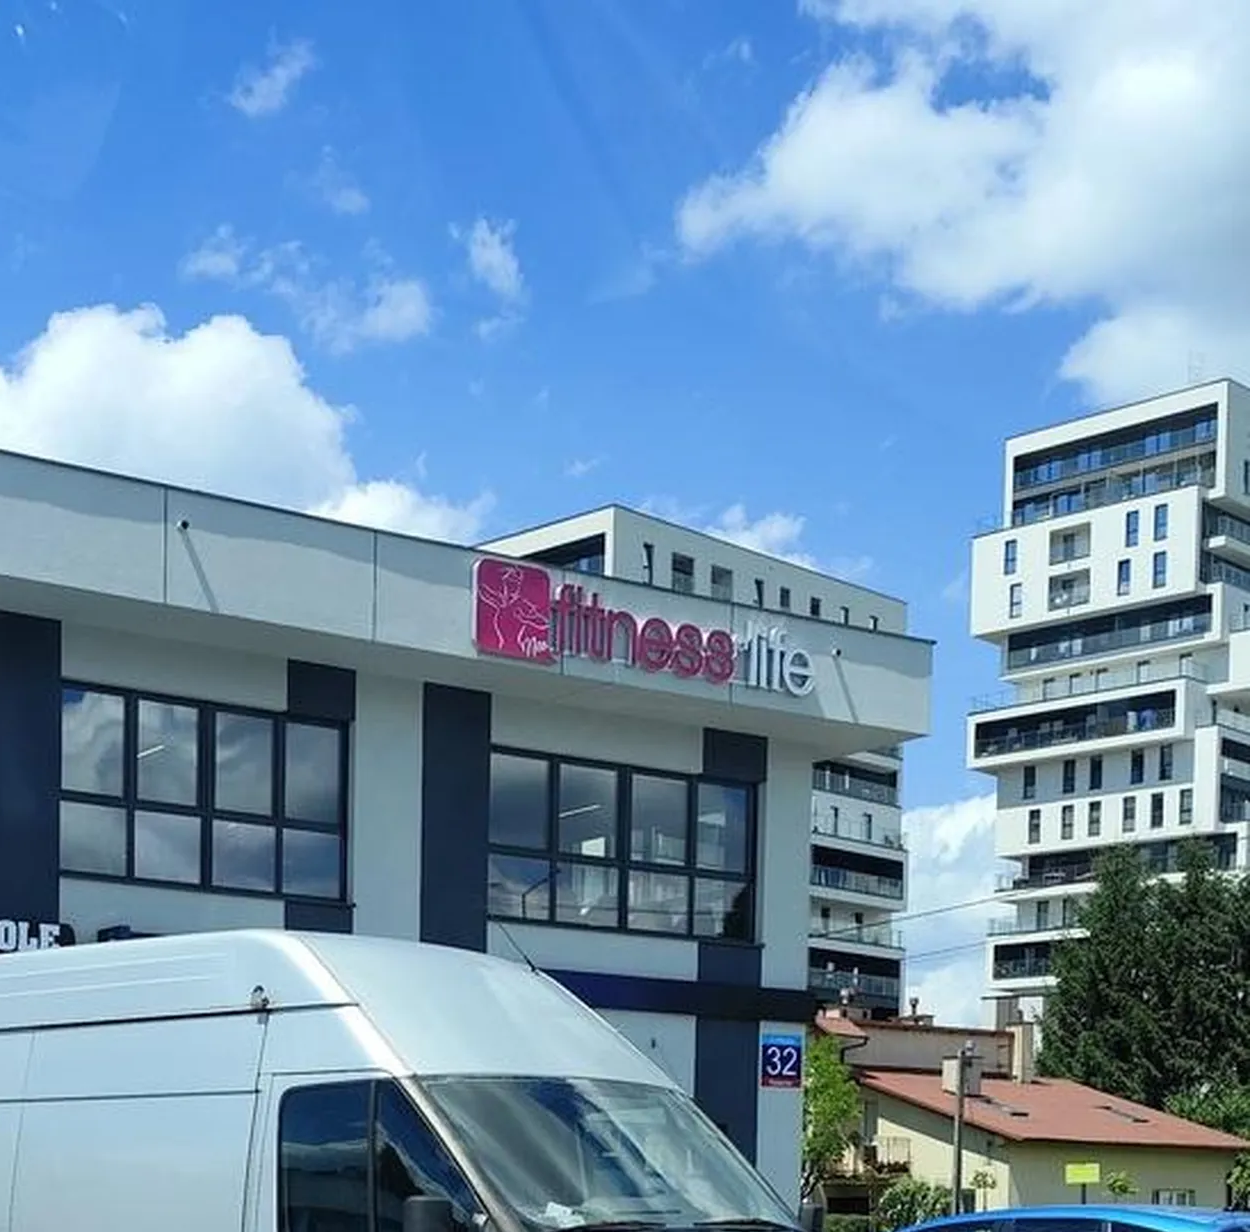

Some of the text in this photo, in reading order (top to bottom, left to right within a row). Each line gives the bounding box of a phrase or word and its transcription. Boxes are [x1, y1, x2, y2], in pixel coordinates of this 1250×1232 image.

[553, 583, 815, 697] fitness life
[766, 1046, 797, 1076] 32
